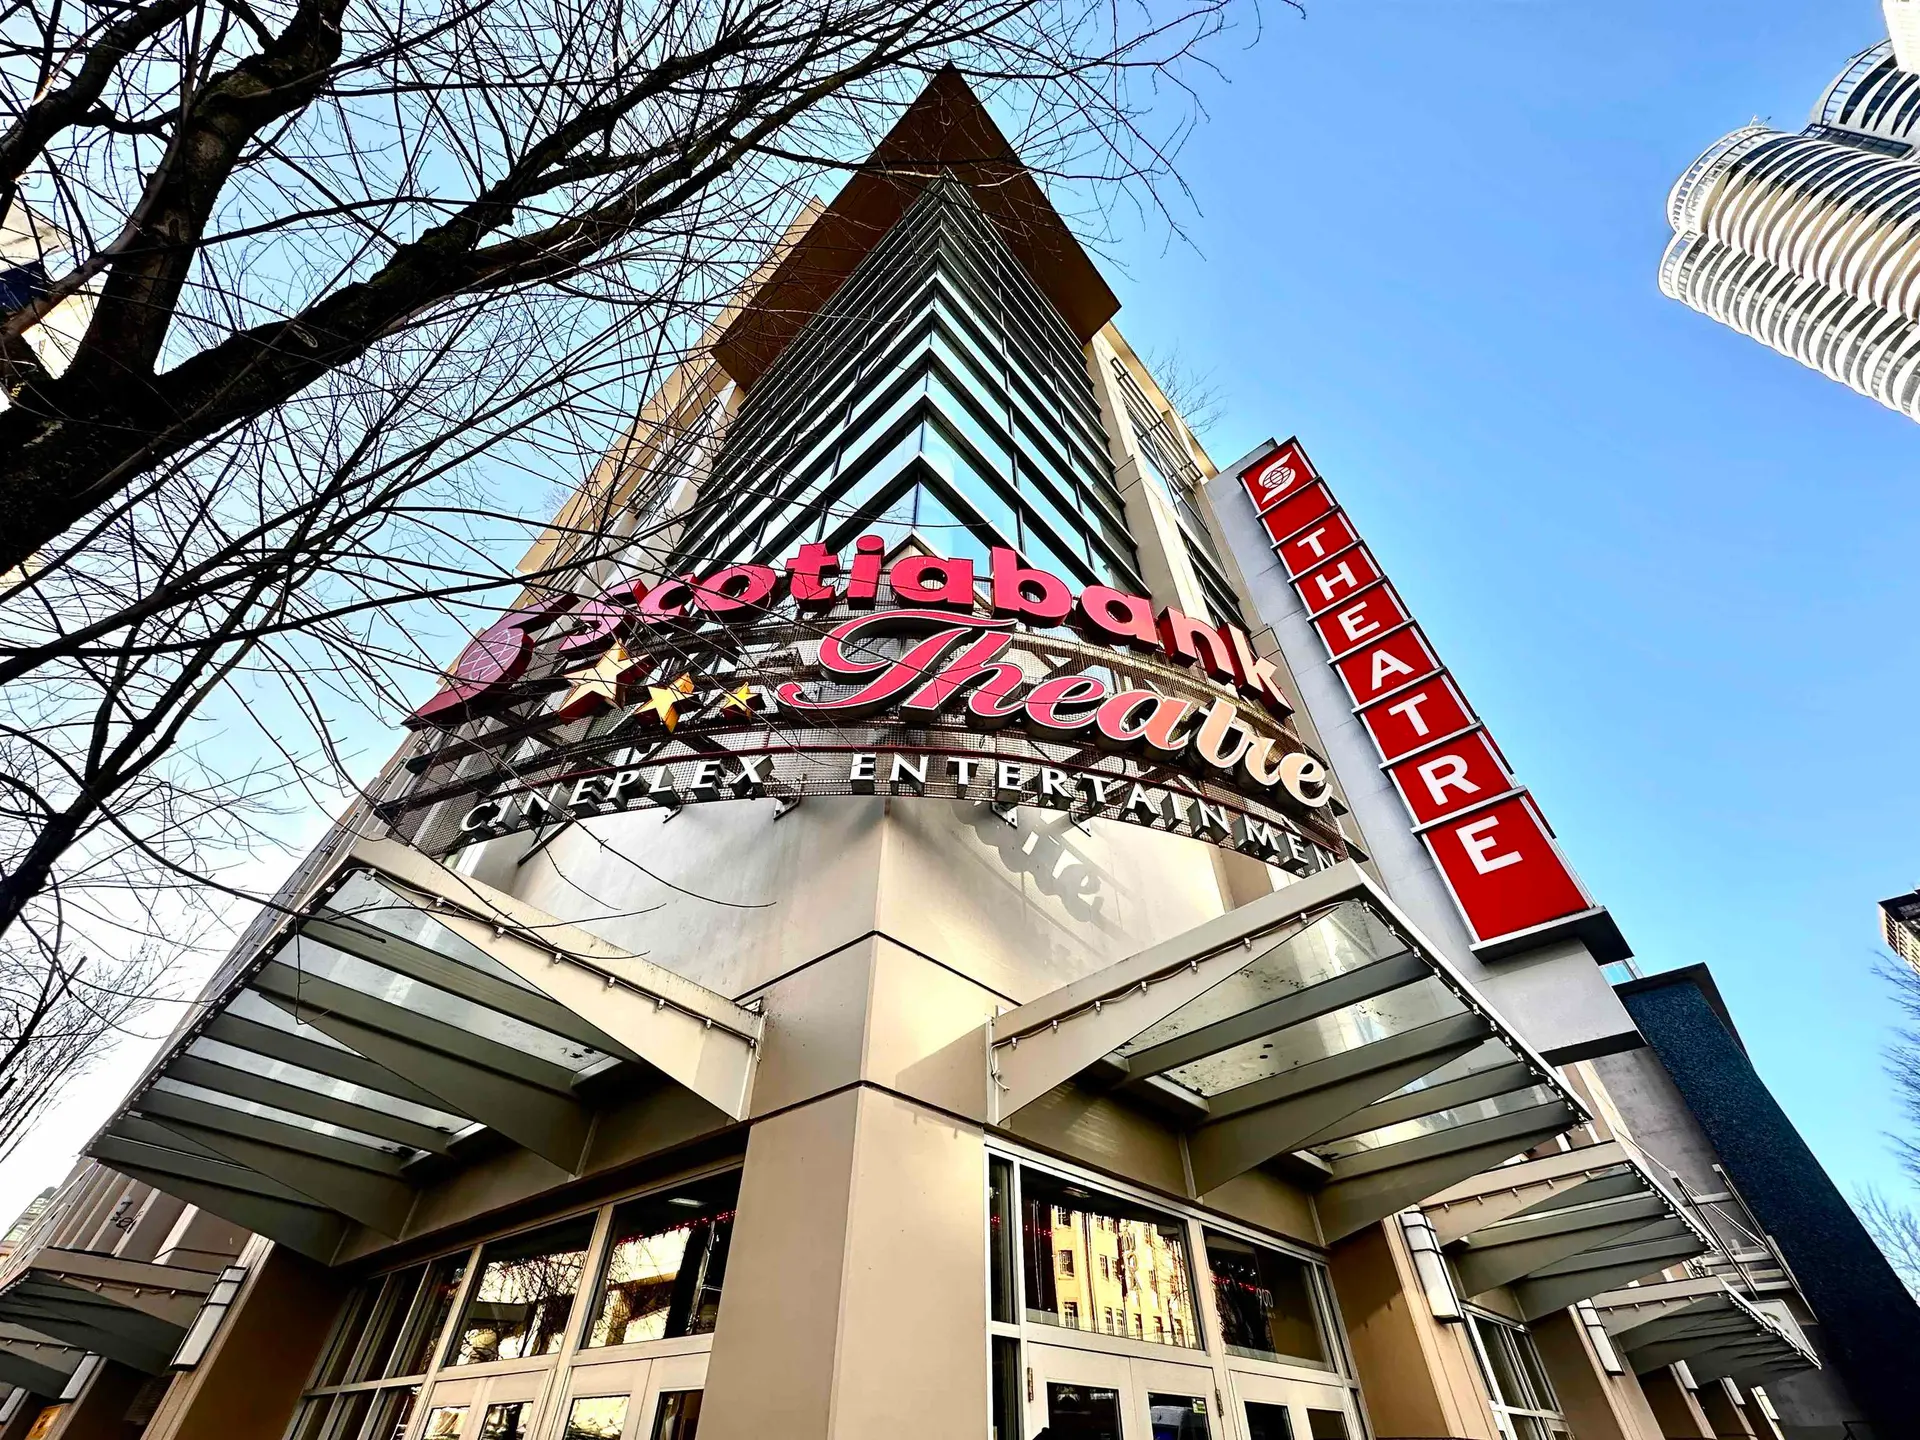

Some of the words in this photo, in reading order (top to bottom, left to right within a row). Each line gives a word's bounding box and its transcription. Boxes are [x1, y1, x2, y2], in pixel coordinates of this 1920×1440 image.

[558, 534, 1294, 715] Scotiabank
[776, 608, 1333, 807] Theatre
[1297, 527, 1523, 875] THEATRE
[460, 755, 774, 832] CINEPLEX
[850, 753, 1336, 872] ENTERTAINMEN
